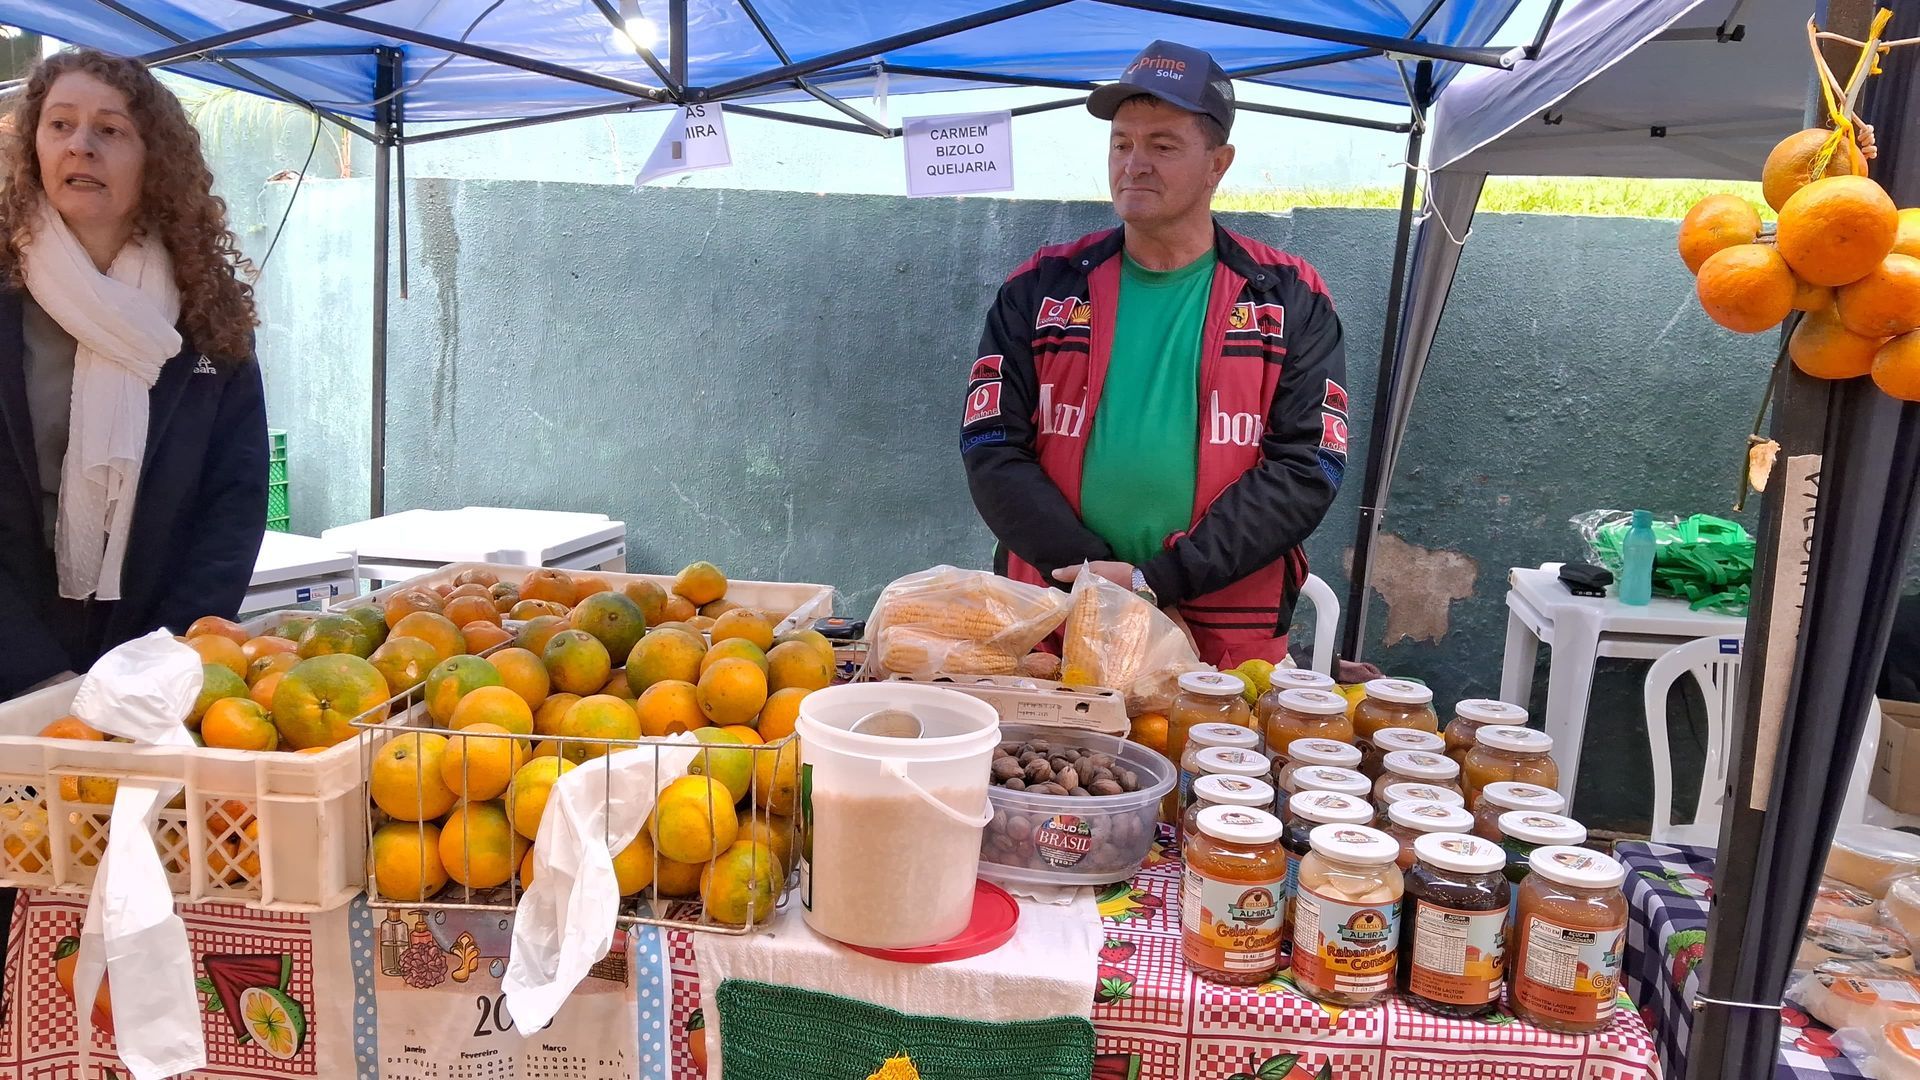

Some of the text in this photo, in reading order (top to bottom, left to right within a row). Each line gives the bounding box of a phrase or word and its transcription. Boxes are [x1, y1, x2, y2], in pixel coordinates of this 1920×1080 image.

[1156, 69, 1184, 81] Solar
[686, 105, 706, 119] AS
[930, 125, 988, 140] CARMEM
[936, 143, 984, 157] BIZOLO
[926, 160, 997, 176] QUEIJARIA
[1039, 831, 1091, 851] BRASIL
[1239, 908, 1272, 917] ALMIRA
[1349, 930, 1384, 939] ALMIRA
[1326, 944, 1387, 958] Rabanete
[473, 993, 554, 1037] 20
[404, 1045, 426, 1054] Janeiro
[460, 1049, 498, 1059] Fevereiro
[542, 1044, 567, 1053] Março
